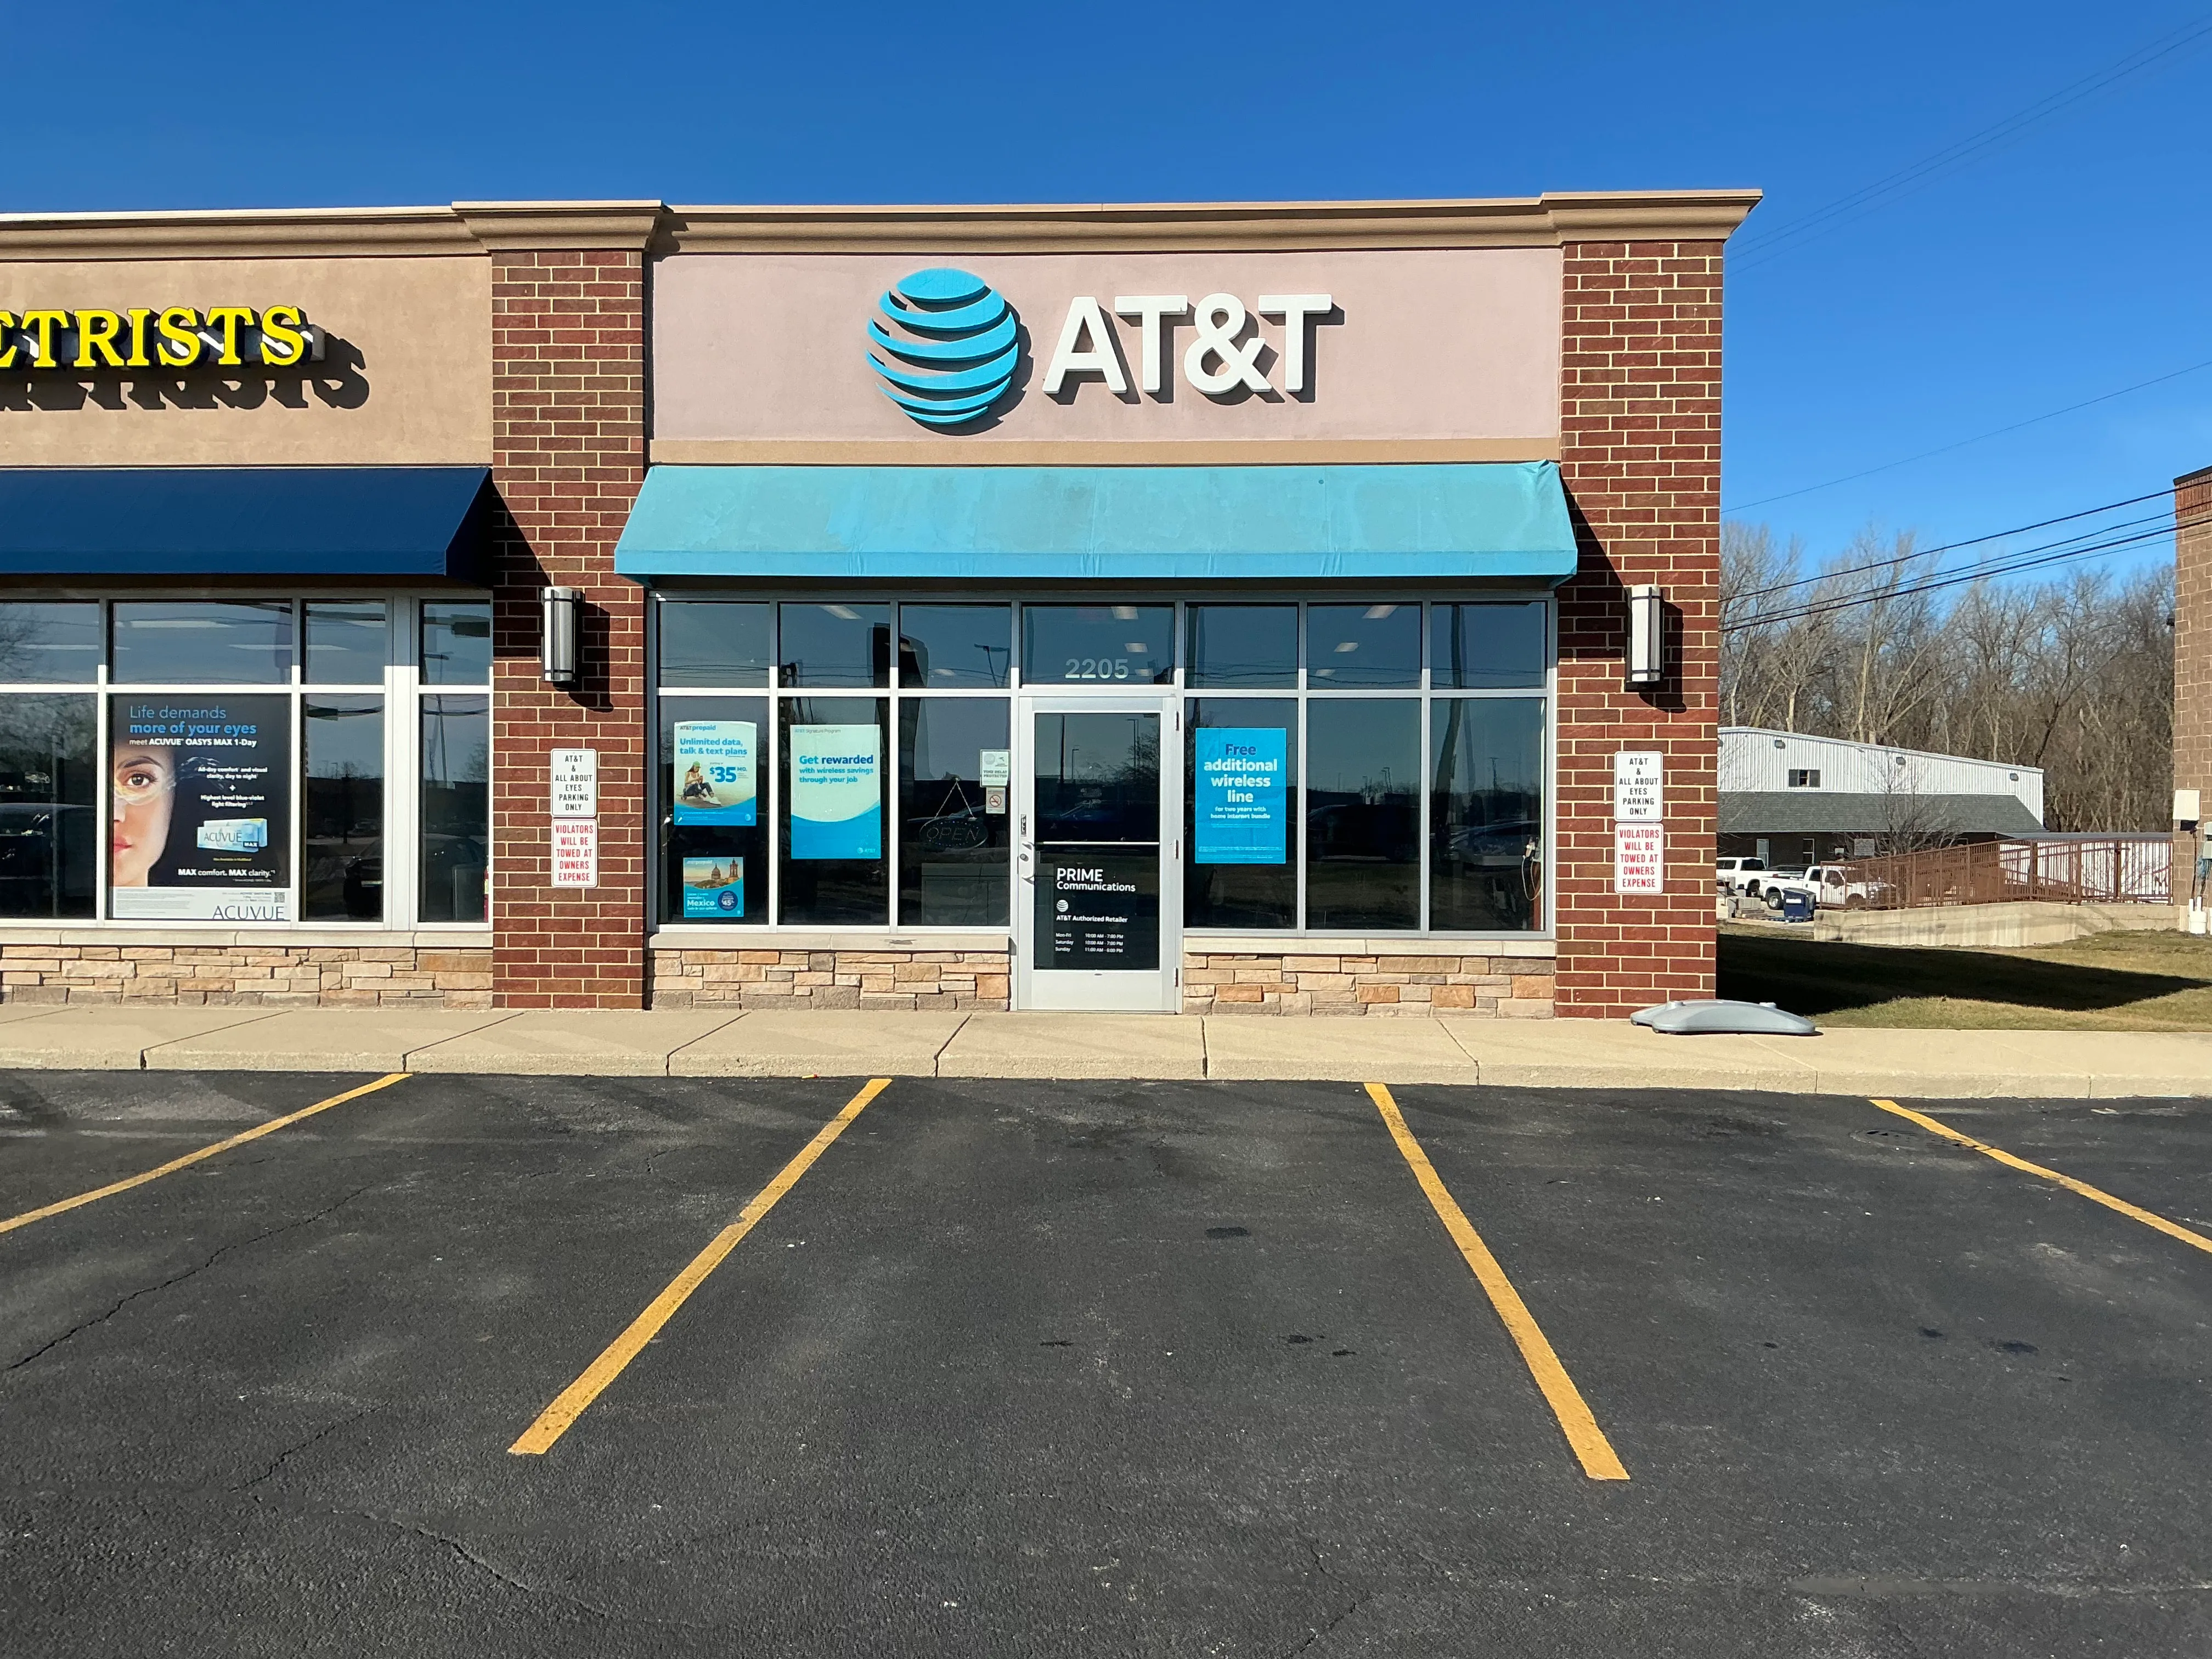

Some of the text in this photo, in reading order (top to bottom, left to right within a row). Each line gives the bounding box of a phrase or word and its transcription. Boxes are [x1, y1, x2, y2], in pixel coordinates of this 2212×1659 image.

[1042, 292, 1332, 394] AT&T
[1065, 658, 1129, 679] 2205
[130, 705, 226, 719] Life demands
[130, 721, 256, 737] more of your eyes
[235, 739, 257, 748] 1-Day
[722, 738, 743, 747] data,
[725, 748, 747, 756] plans
[1226, 743, 1257, 755] Free
[799, 754, 873, 764] Get rewarded
[1204, 758, 1277, 771] additional
[709, 766, 736, 782] $35
[1211, 774, 1271, 787] wireless
[1228, 790, 1254, 803] line
[556, 825, 593, 833] VIOLATORS
[927, 827, 980, 840] OPEN
[1620, 830, 1660, 838] VIOLATORS
[204, 832, 242, 843] ACUVUE
[1624, 842, 1654, 850] WILL BE
[1620, 854, 1658, 862] TOWED AT
[560, 861, 589, 869] OWNERS
[1623, 866, 1655, 874] OWNERS
[559, 873, 590, 881] EXPENSE
[1057, 868, 1103, 882] PRIME
[1057, 881, 1136, 892] Communications
[1623, 879, 1655, 887] EXPENSE
[212, 906, 284, 920] ACUVUE
